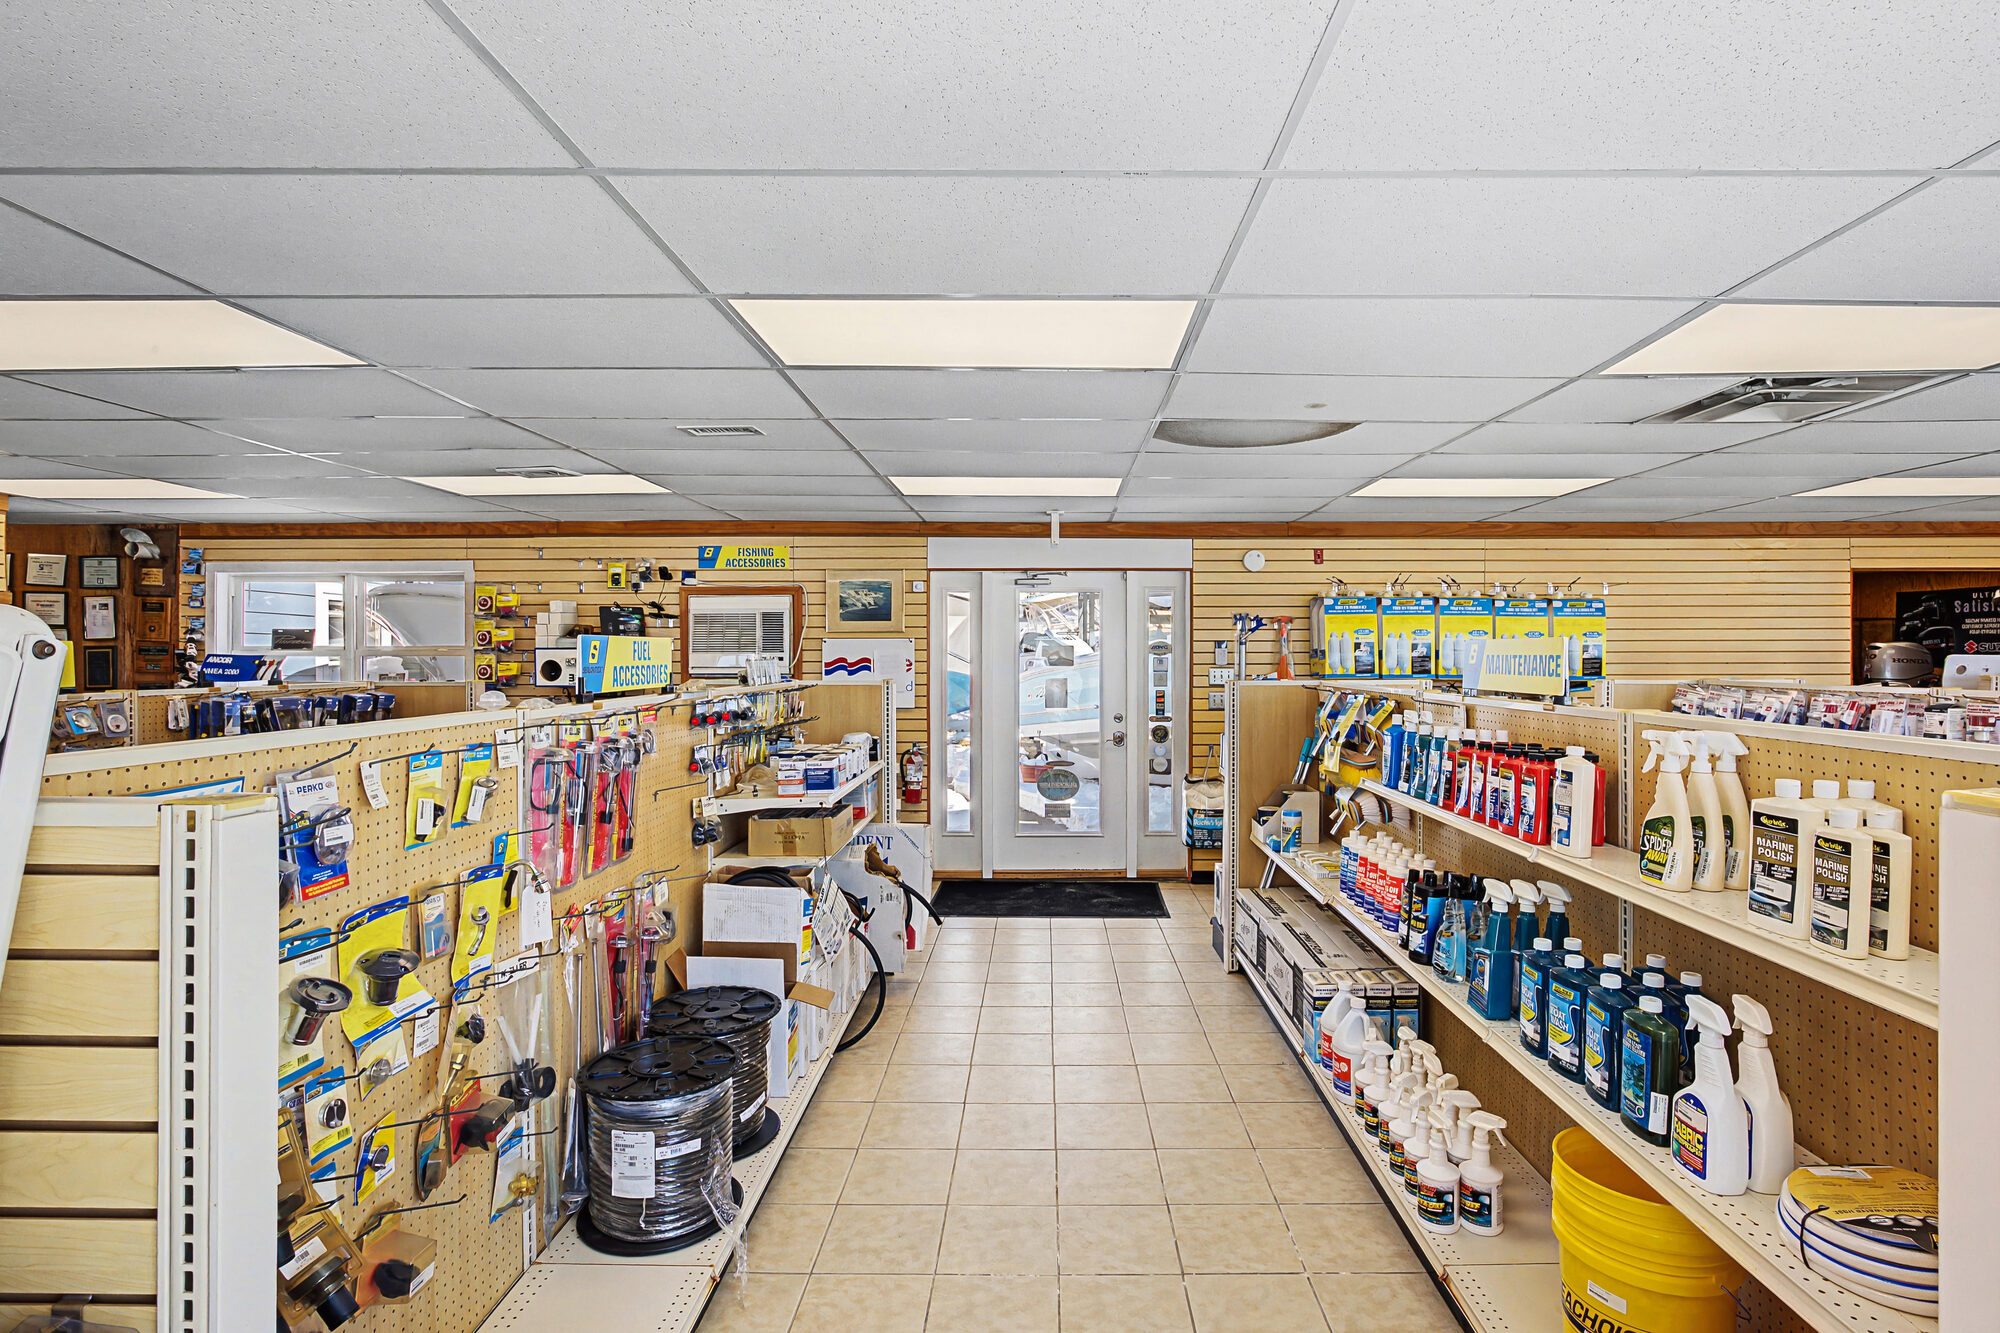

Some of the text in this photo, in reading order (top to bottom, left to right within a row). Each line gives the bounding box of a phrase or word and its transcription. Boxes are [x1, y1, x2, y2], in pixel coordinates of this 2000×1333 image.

[737, 547, 774, 557] FISHING
[725, 558, 786, 568] ACCESSORIES
[632, 640, 652, 661] FUEL
[206, 656, 233, 664] ANCOR
[1484, 653, 1562, 678] MAINTENANCE
[1892, 657, 1930, 665] HONDA
[612, 664, 668, 688] ACCESSORIES
[296, 782, 324, 795] PERKO
[1640, 834, 1673, 854] SPIDER
[1756, 836, 1794, 854] MARINE
[1644, 848, 1669, 864] AWAY
[1757, 846, 1793, 864] POLISH
[1815, 857, 1849, 875] MARINE
[1816, 866, 1847, 884] POLISH
[1674, 1116, 1704, 1150] FABRIC
